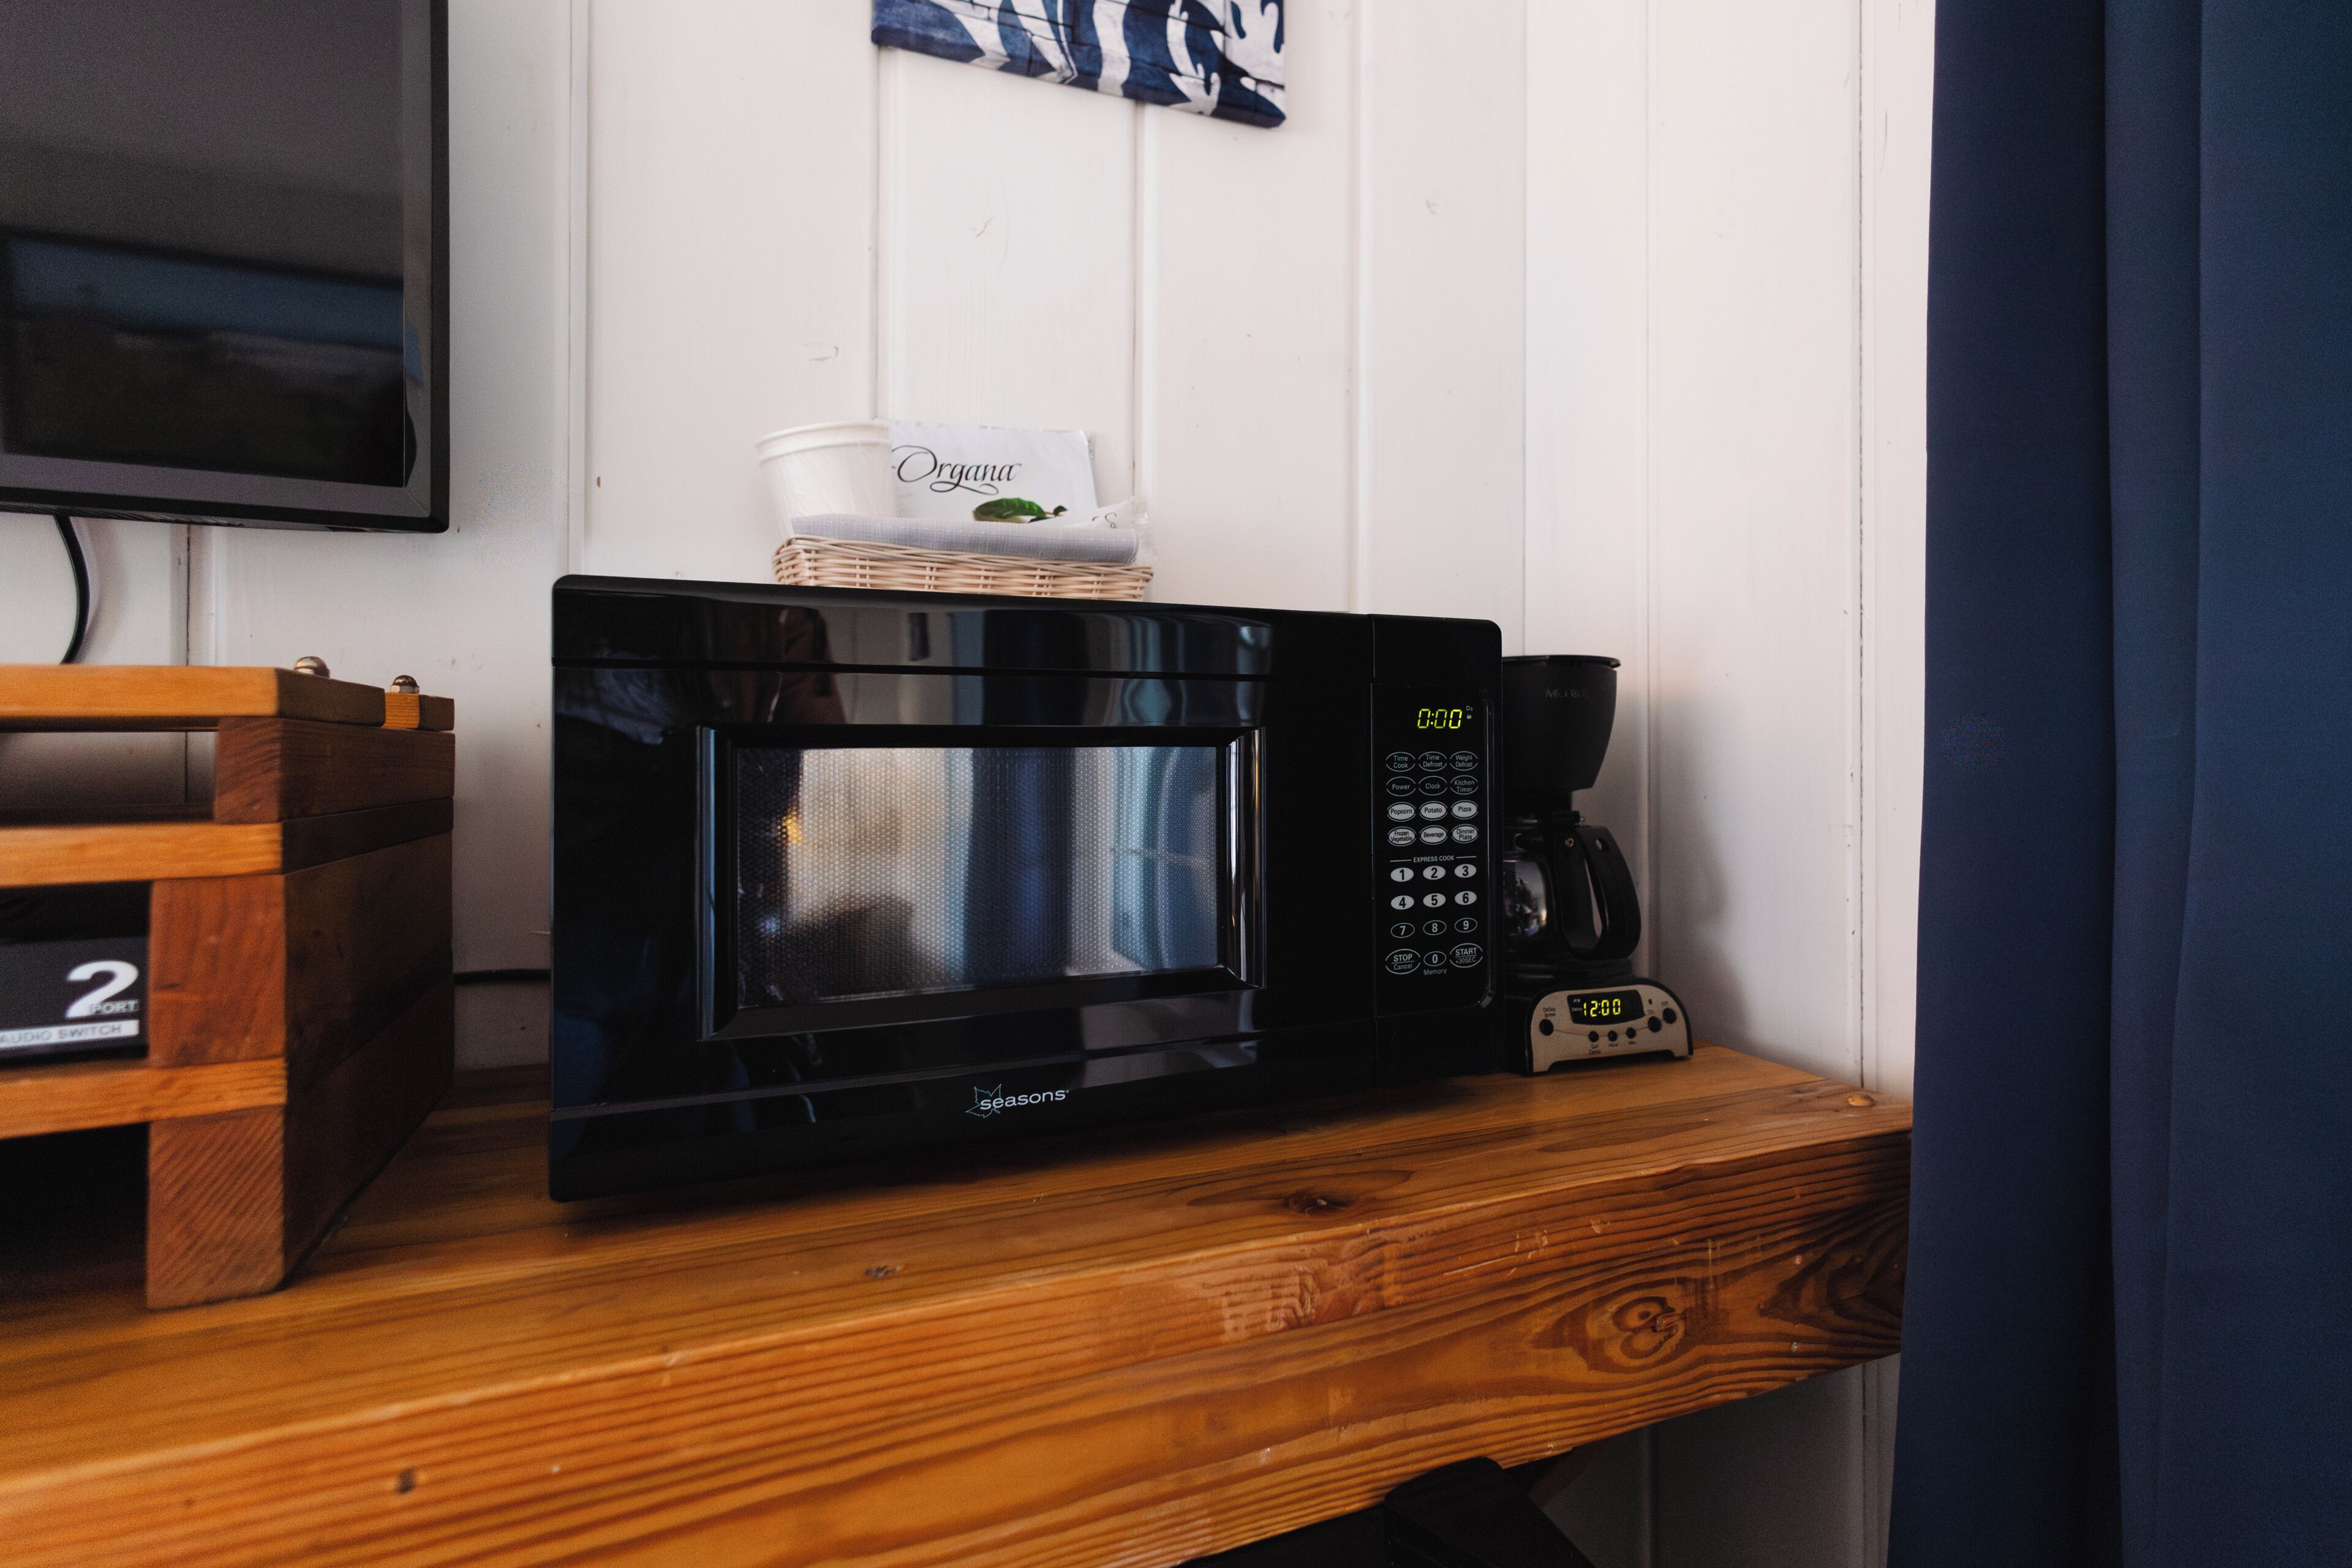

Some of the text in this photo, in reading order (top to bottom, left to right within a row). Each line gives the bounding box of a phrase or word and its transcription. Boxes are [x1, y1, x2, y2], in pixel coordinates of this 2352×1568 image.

[892, 445, 1022, 495] Organa
[1417, 709, 1462, 729] 0:00
[1400, 869, 1404, 880] 1
[1431, 868, 1438, 878] 2
[1462, 865, 1469, 876] 3
[1399, 897, 1406, 908] 4
[1431, 895, 1438, 905] 5
[1463, 892, 1469, 903] 6
[1400, 925, 1406, 935] 7
[1431, 923, 1438, 933] 8
[1463, 921, 1469, 930] 9
[1393, 954, 1412, 962] STOP
[1432, 954, 1438, 963] 0
[65, 960, 139, 1018] 2
[91, 1000, 139, 1014] PORT
[1583, 998, 1621, 1017] 12:00
[58, 1024, 121, 1040] SWITCH
